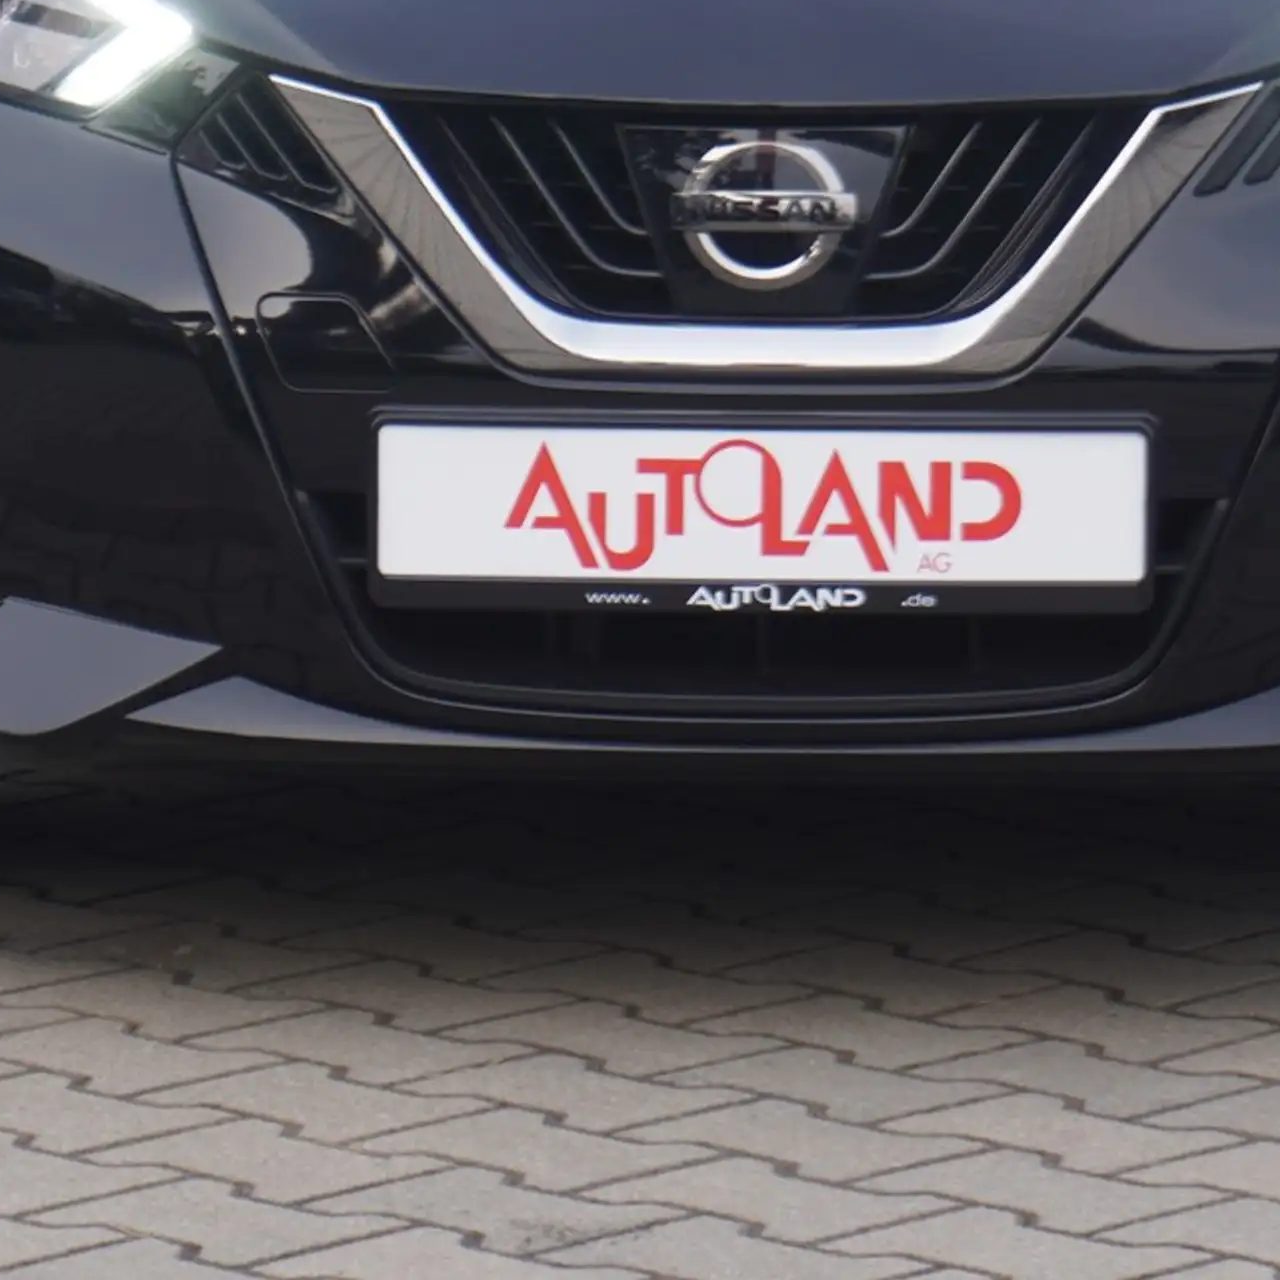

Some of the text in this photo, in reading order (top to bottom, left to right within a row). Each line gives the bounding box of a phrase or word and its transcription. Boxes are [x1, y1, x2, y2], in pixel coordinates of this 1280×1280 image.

[504, 439, 1022, 572] AUTOLAND
[917, 553, 952, 574] AG
[585, 584, 939, 612] www. AUTOLAND .de
